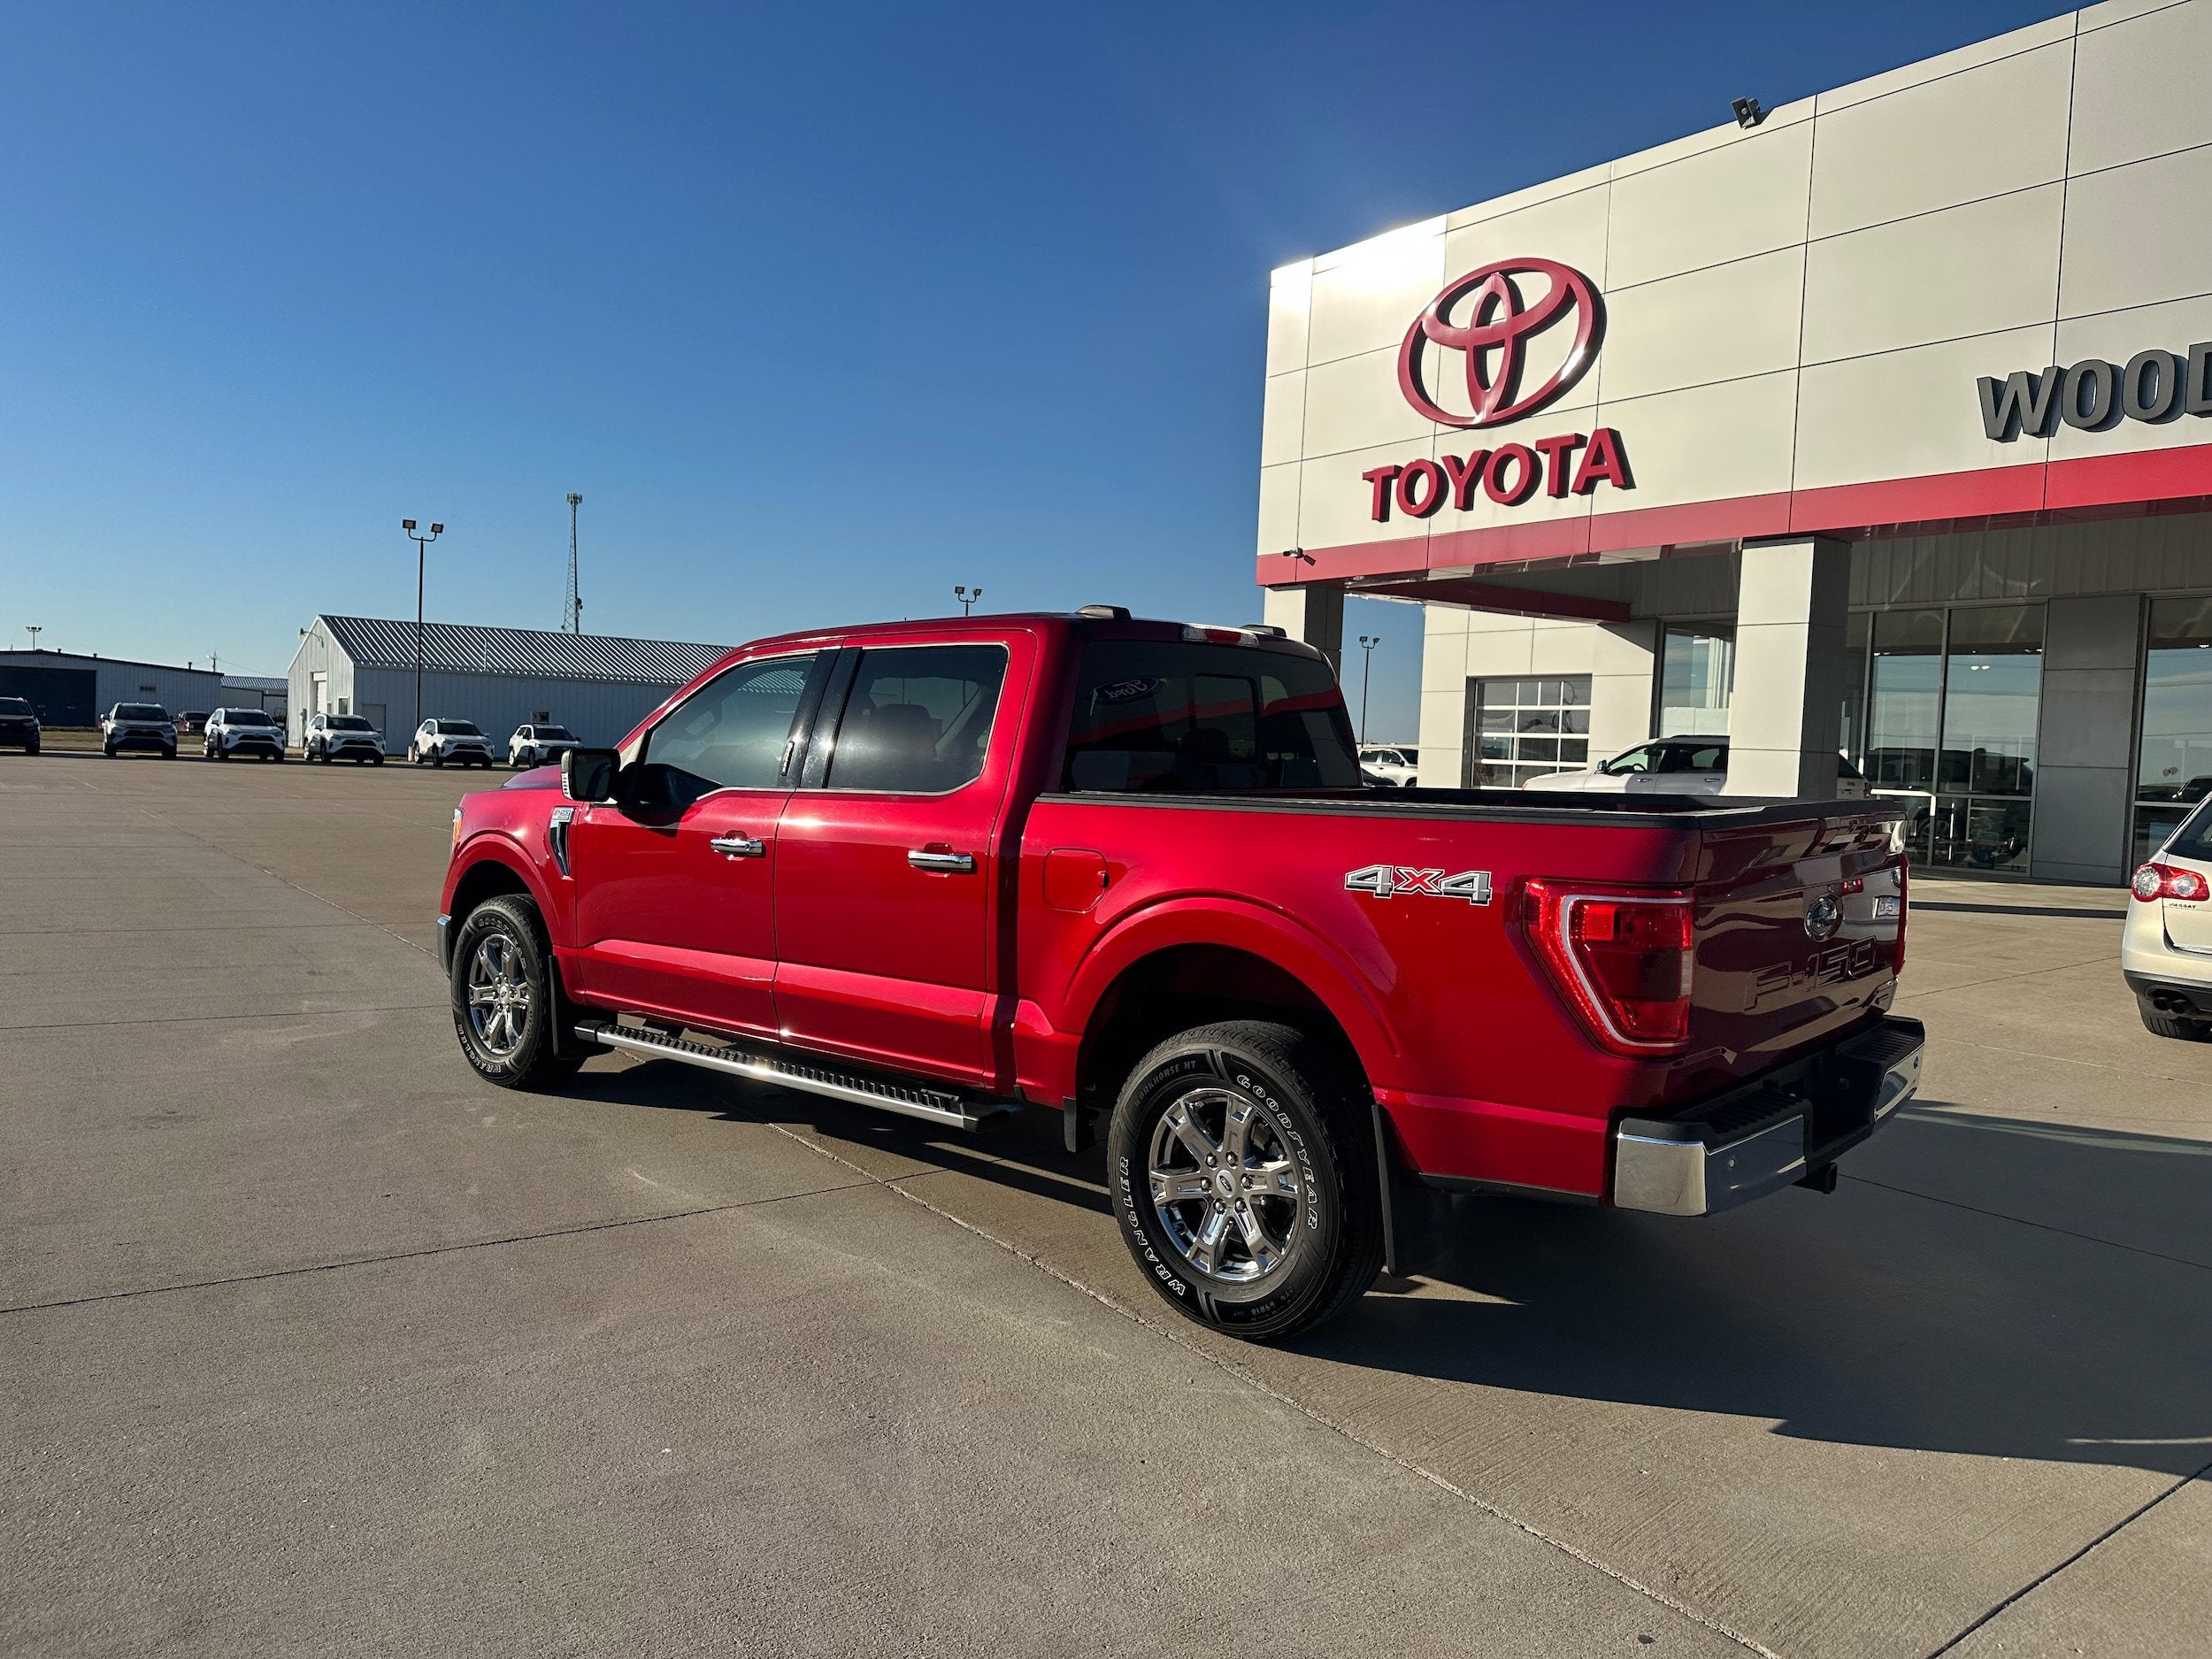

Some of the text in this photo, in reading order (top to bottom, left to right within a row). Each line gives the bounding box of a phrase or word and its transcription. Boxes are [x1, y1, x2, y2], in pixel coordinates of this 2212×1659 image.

[1363, 427, 1636, 523] TOYOTA
[478, 918, 527, 970] GOODYEAR
[1744, 935, 1878, 1011] F-150
[1237, 1075, 1318, 1230] GOODYEAR
[1119, 1156, 1187, 1296] WRANGLER
